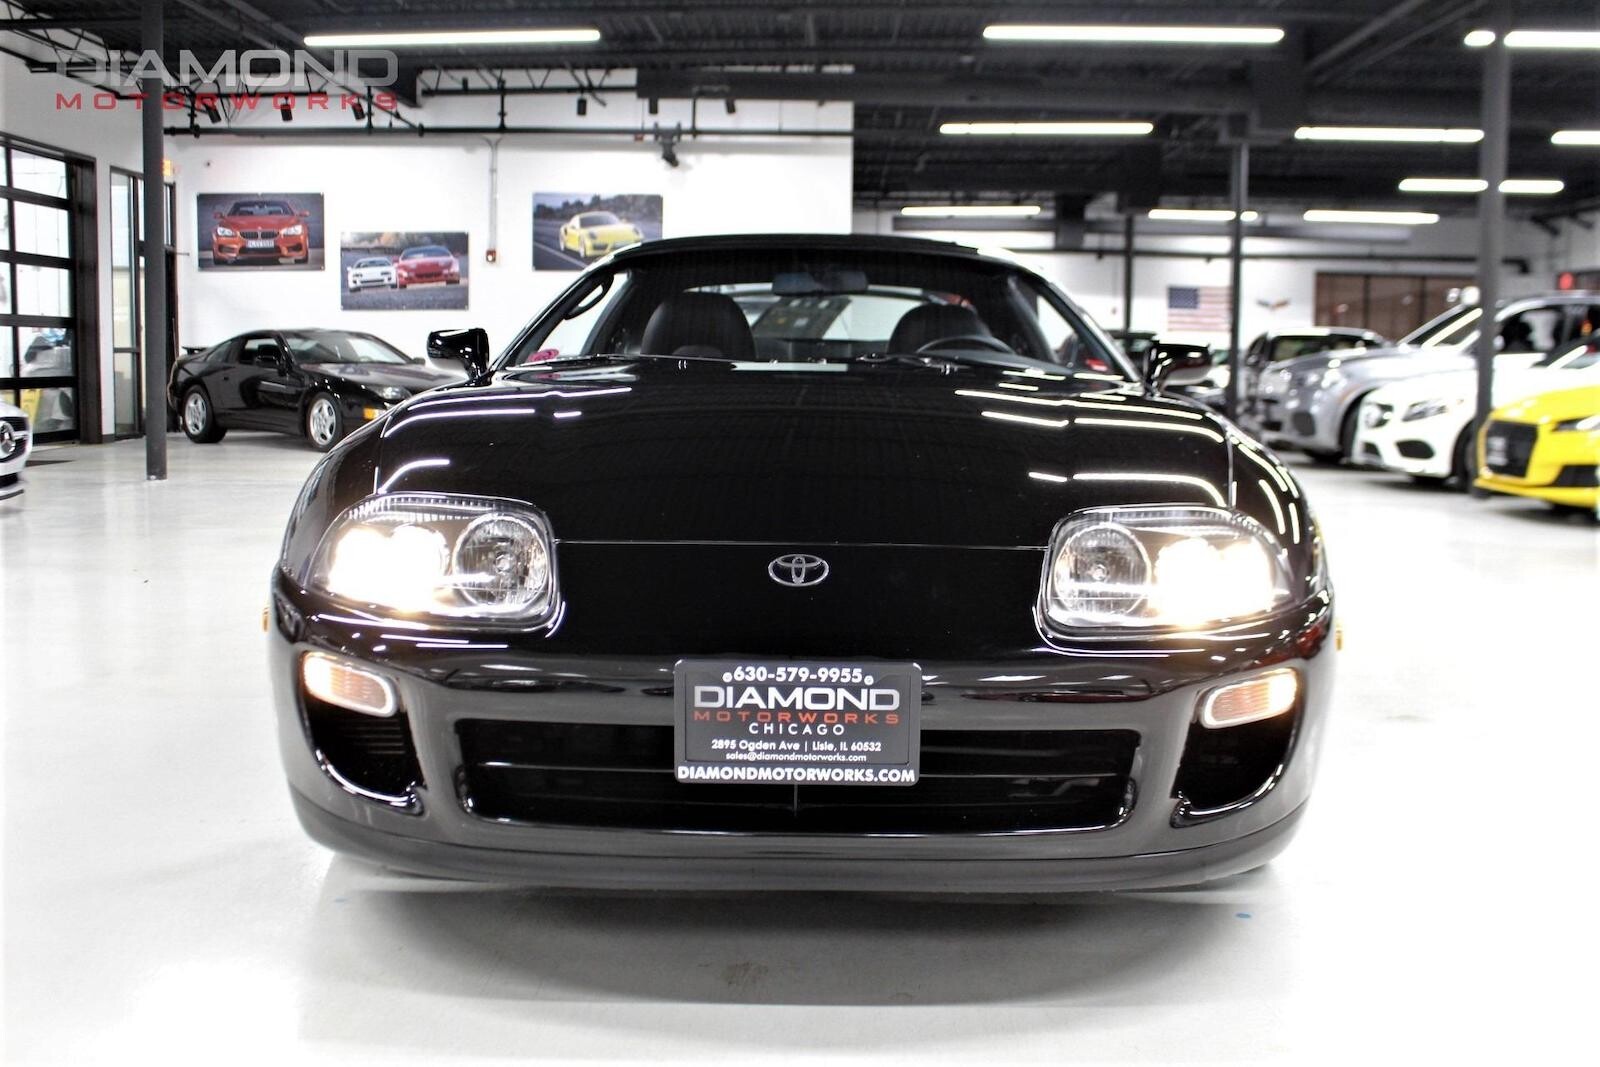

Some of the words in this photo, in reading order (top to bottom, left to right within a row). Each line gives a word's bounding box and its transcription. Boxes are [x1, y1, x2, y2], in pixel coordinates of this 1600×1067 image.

[733, 666, 863, 684] 630-579-9955
[694, 686, 900, 711] DIAMOND
[694, 711, 899, 724] MOTORWORKS
[749, 723, 845, 736] CHICAGO
[711, 739, 737, 750] 2895
[739, 740, 776, 752] Ogden
[779, 741, 801, 751] Ave
[812, 741, 837, 752] Lisle,
[840, 741, 849, 751] IL
[850, 741, 882, 752] 60532
[726, 750, 867, 762] sales@diamondmotorworks.com
[677, 766, 916, 783] DIAMONDMOTORWORKS.COM
